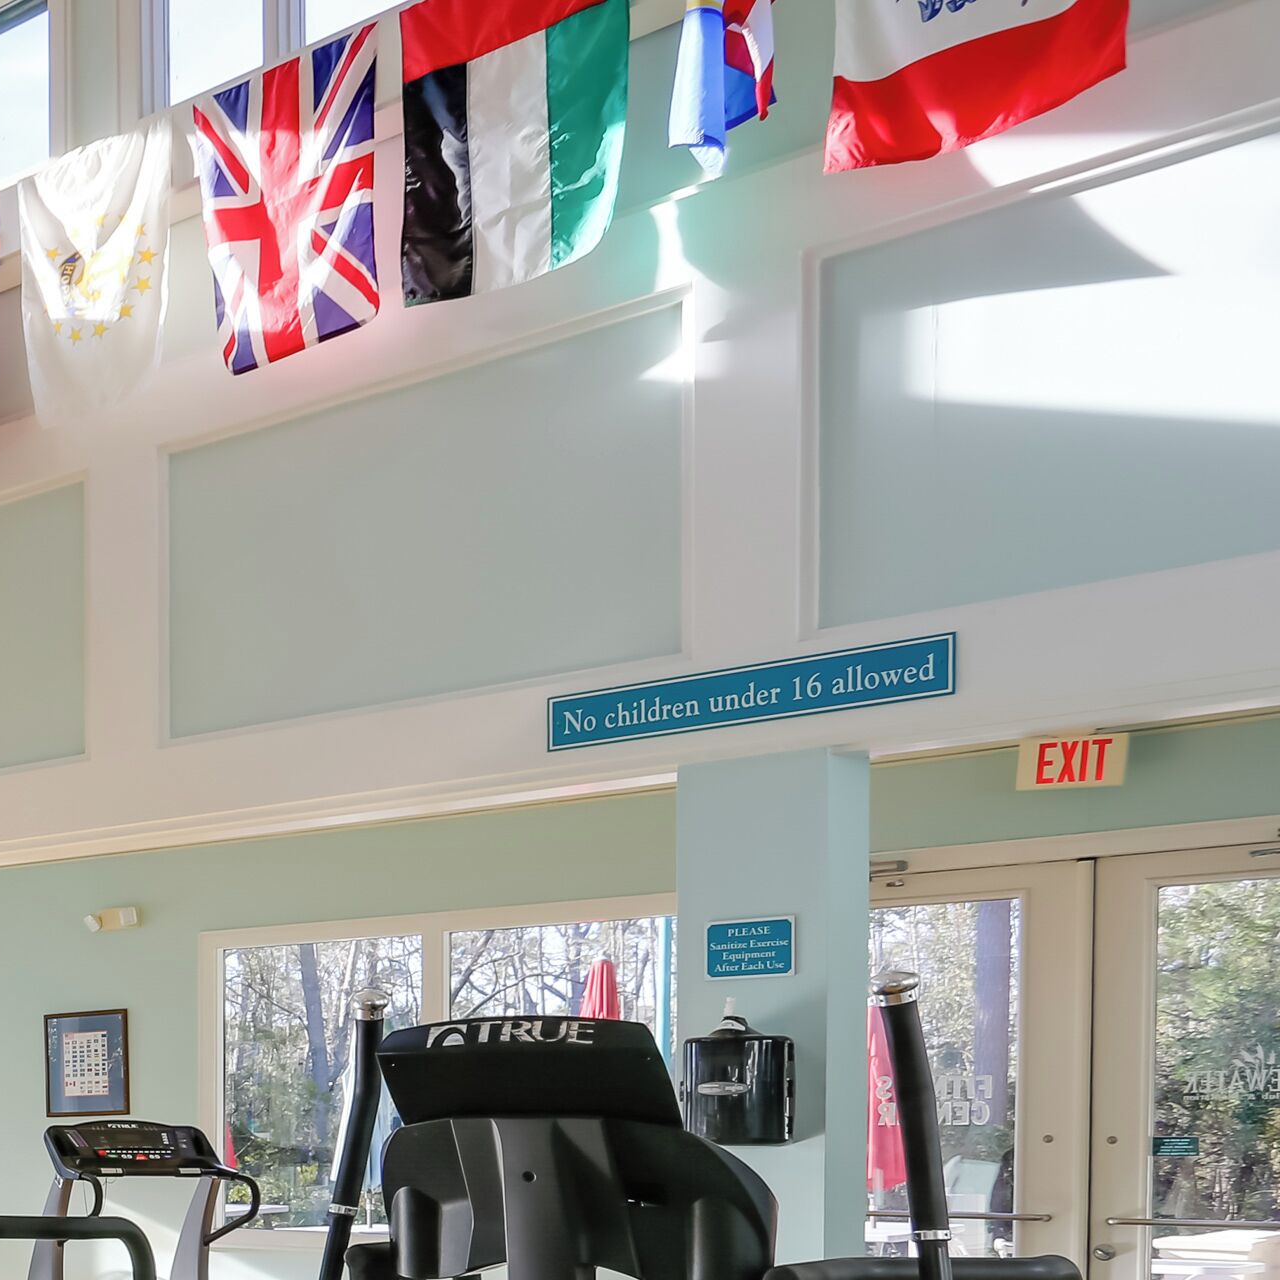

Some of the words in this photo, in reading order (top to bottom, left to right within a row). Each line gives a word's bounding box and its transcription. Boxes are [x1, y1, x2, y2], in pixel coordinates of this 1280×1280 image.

[563, 709, 596, 735] No
[604, 697, 700, 729] children
[709, 680, 780, 712] under
[792, 672, 822, 701] 16
[831, 653, 935, 695] allowed
[1035, 738, 1113, 785] EXIT
[727, 926, 771, 937] PLEASE
[710, 941, 748, 951] Sanitize
[750, 938, 789, 948] Exercise
[722, 951, 776, 962] Equipment
[714, 963, 739, 972] After
[742, 961, 765, 970] Each
[766, 960, 785, 969] Use
[472, 1020, 596, 1044] TRUE
